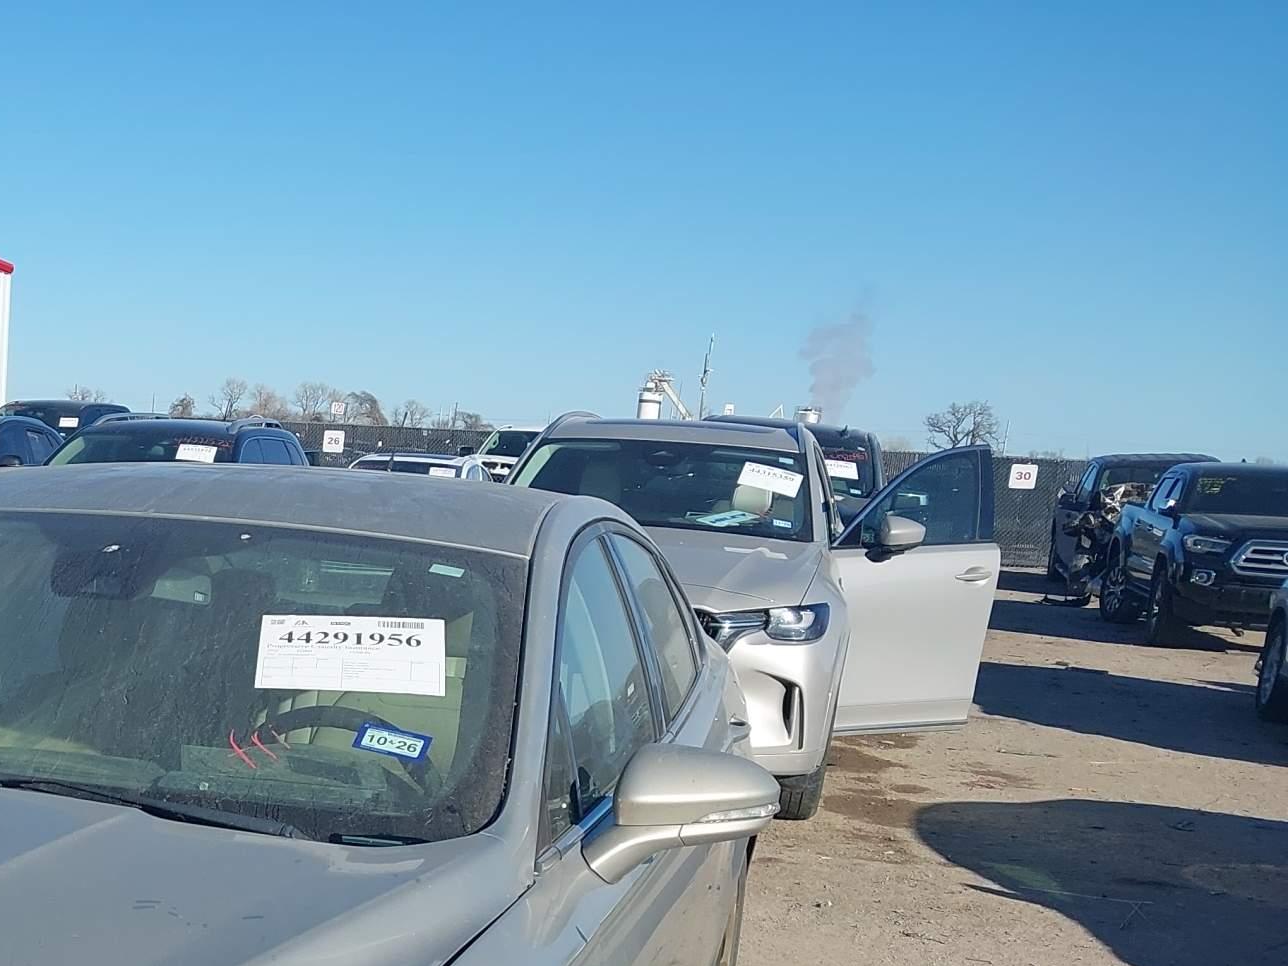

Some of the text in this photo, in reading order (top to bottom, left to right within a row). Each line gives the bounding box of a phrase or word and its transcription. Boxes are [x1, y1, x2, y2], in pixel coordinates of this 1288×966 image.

[327, 437, 340, 445] 26
[1015, 471, 1032, 480] 30
[278, 631, 422, 648] 44291956
